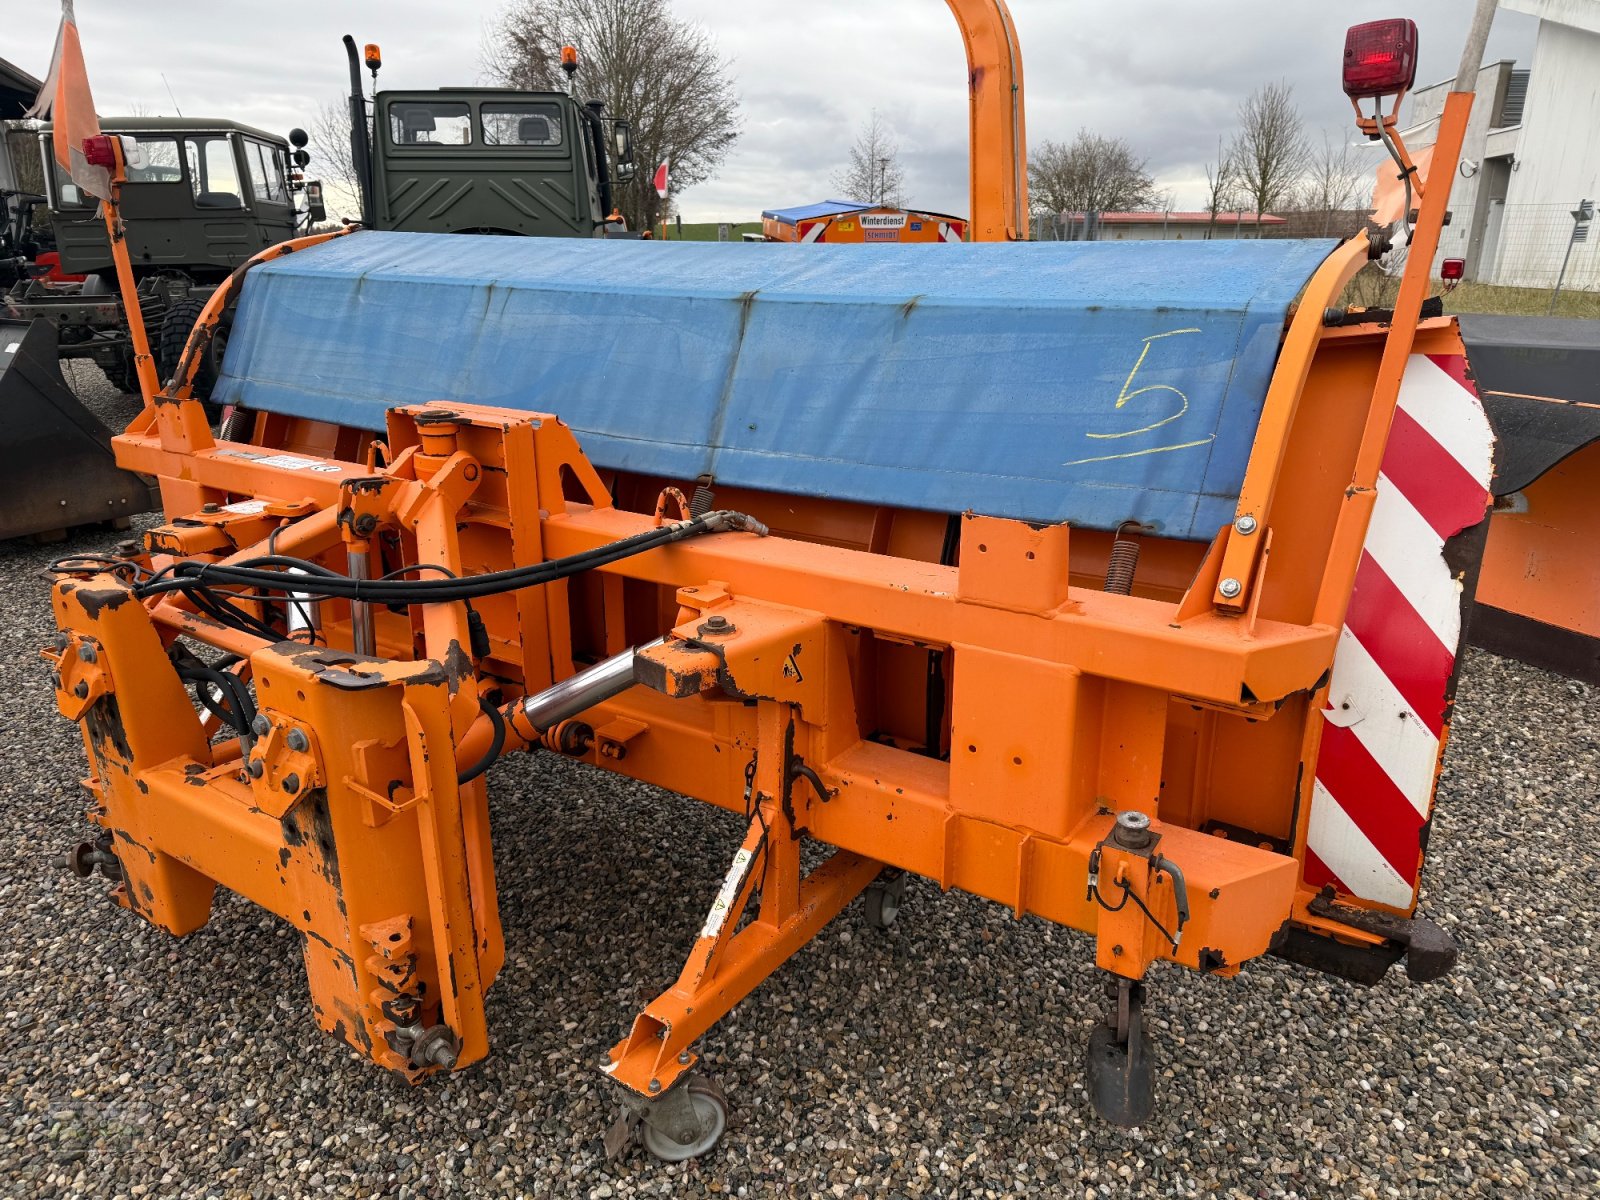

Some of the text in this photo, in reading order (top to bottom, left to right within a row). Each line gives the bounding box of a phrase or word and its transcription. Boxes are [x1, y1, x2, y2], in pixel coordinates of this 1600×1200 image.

[861, 215, 904, 226] Winterdienst
[867, 231, 896, 239] SCHMIDT
[1086, 327, 1202, 439] 5
